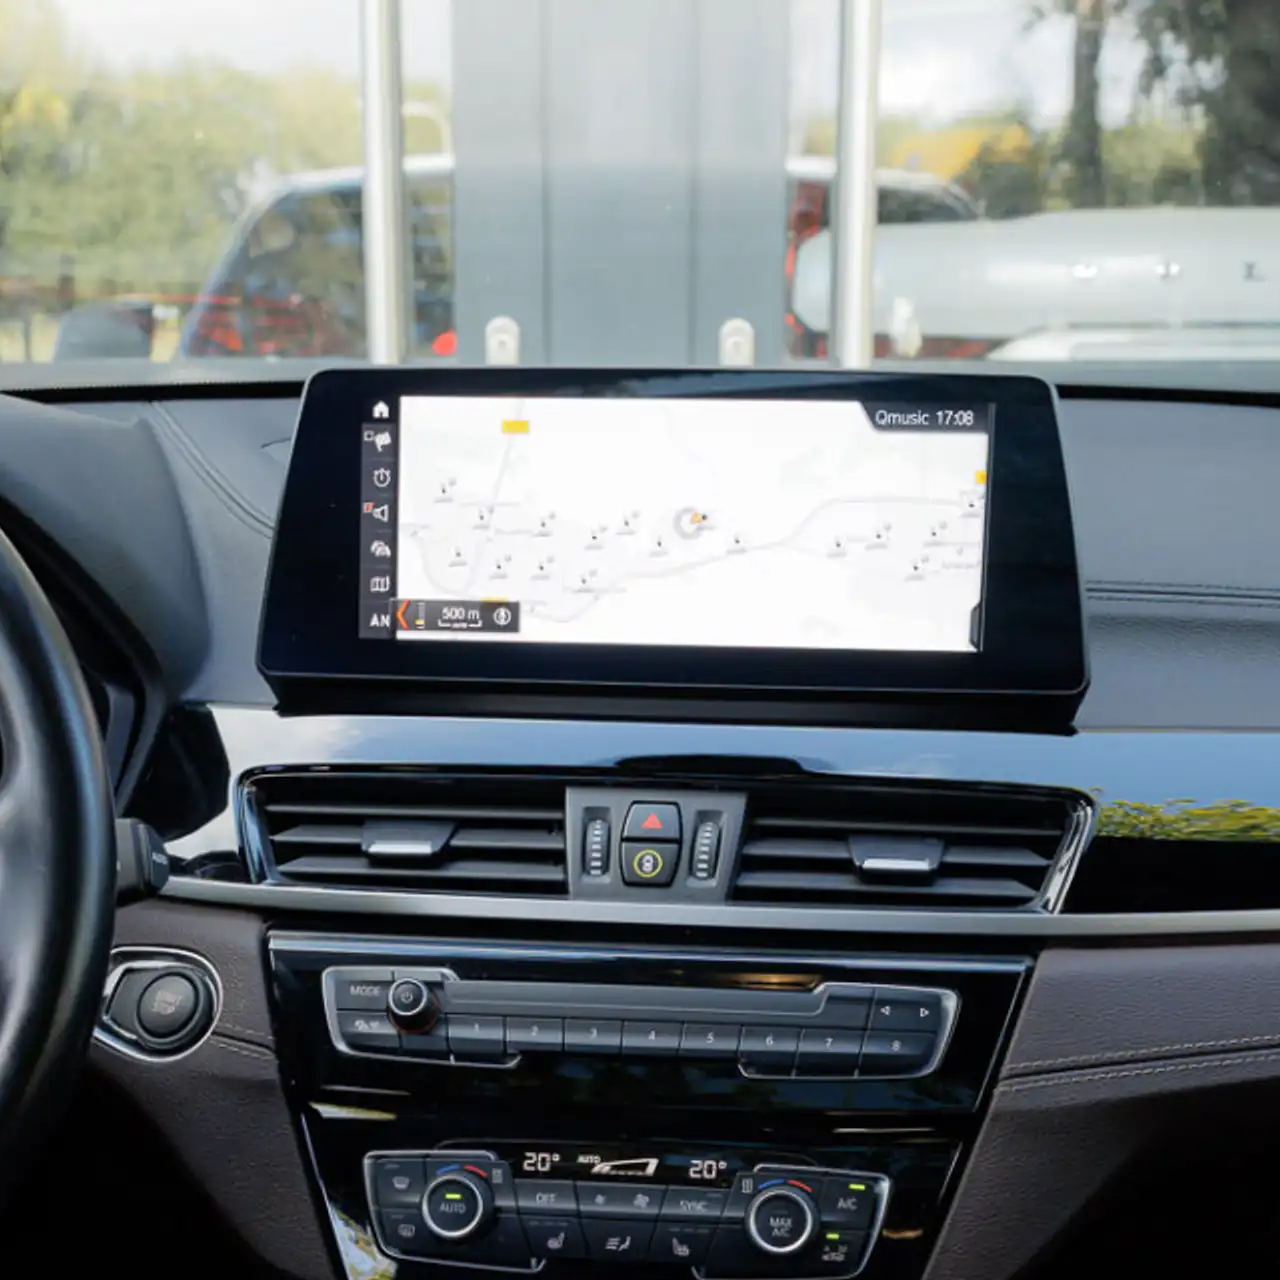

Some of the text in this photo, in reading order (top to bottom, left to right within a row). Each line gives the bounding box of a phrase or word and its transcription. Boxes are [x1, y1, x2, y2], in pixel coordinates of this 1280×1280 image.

[875, 409, 974, 425] Qmusic 17:08
[442, 606, 480, 620] 500 m
[350, 984, 381, 997] MODE
[531, 1025, 539, 1037] 2
[590, 1027, 598, 1040] 3
[648, 1029, 656, 1041] 4
[706, 1031, 715, 1044] 5
[765, 1035, 774, 1046] 6
[825, 1036, 834, 1047] 7
[523, 1152, 561, 1172] 20°
[577, 1154, 602, 1164] AUTO
[688, 1159, 727, 1179] 20°
[535, 1191, 557, 1204] OFF
[836, 1197, 858, 1211] A/C
[439, 1202, 466, 1214] AUTO
[679, 1200, 709, 1213] SYNC
